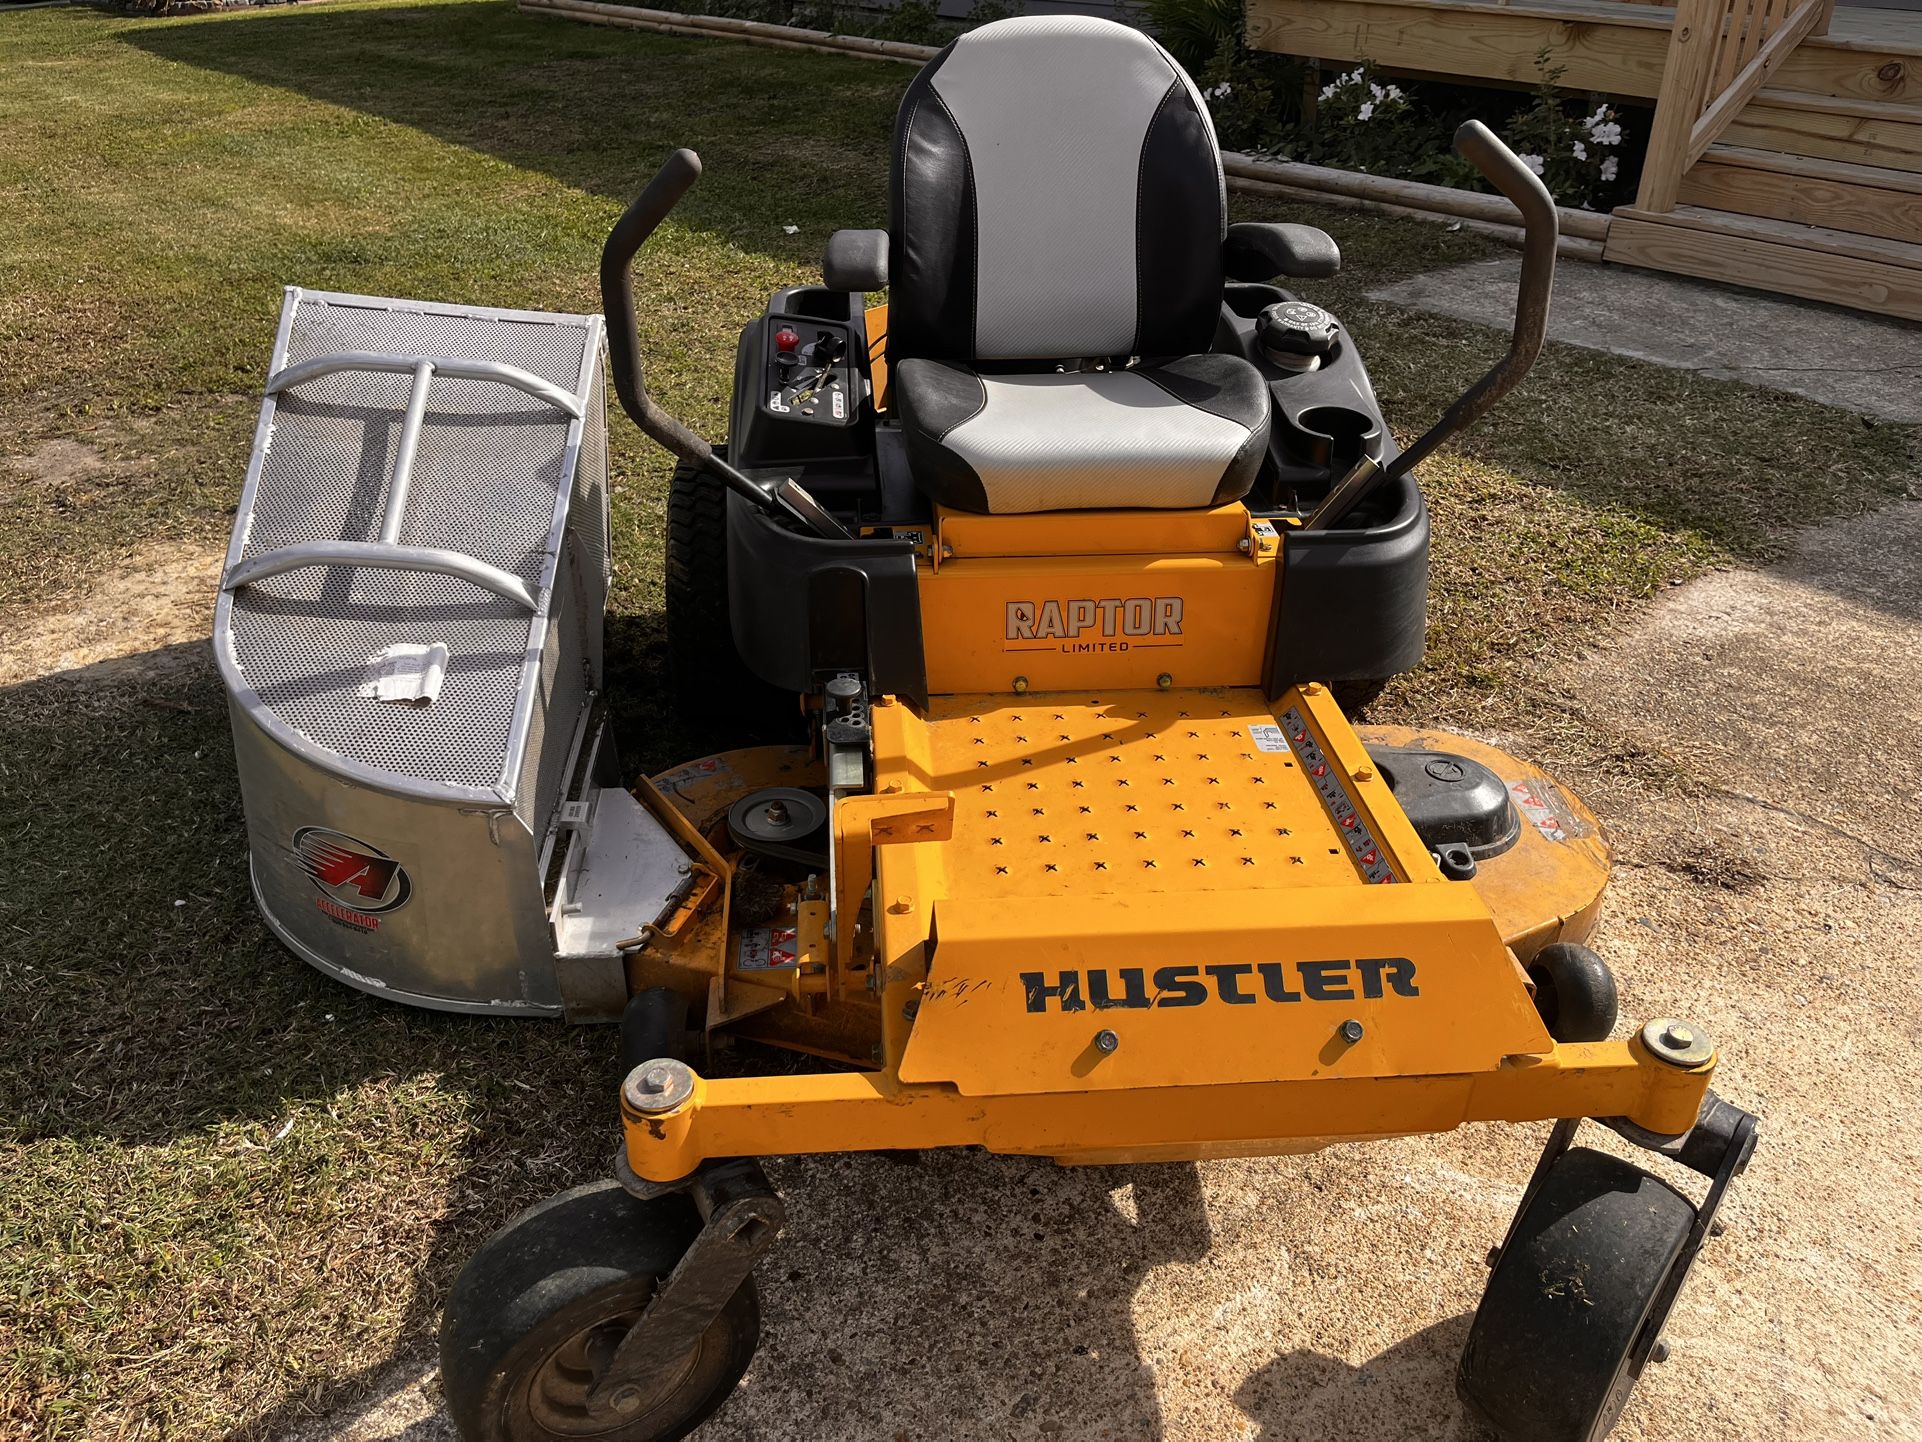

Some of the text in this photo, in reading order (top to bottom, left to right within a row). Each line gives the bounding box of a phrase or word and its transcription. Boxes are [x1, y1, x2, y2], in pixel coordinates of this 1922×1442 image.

[1006, 597, 1184, 640] RAPTOR
[1062, 642, 1129, 653] LIMITED
[316, 898, 380, 929] ACCELERATOR
[1019, 957, 1419, 1013] HUSTLER
